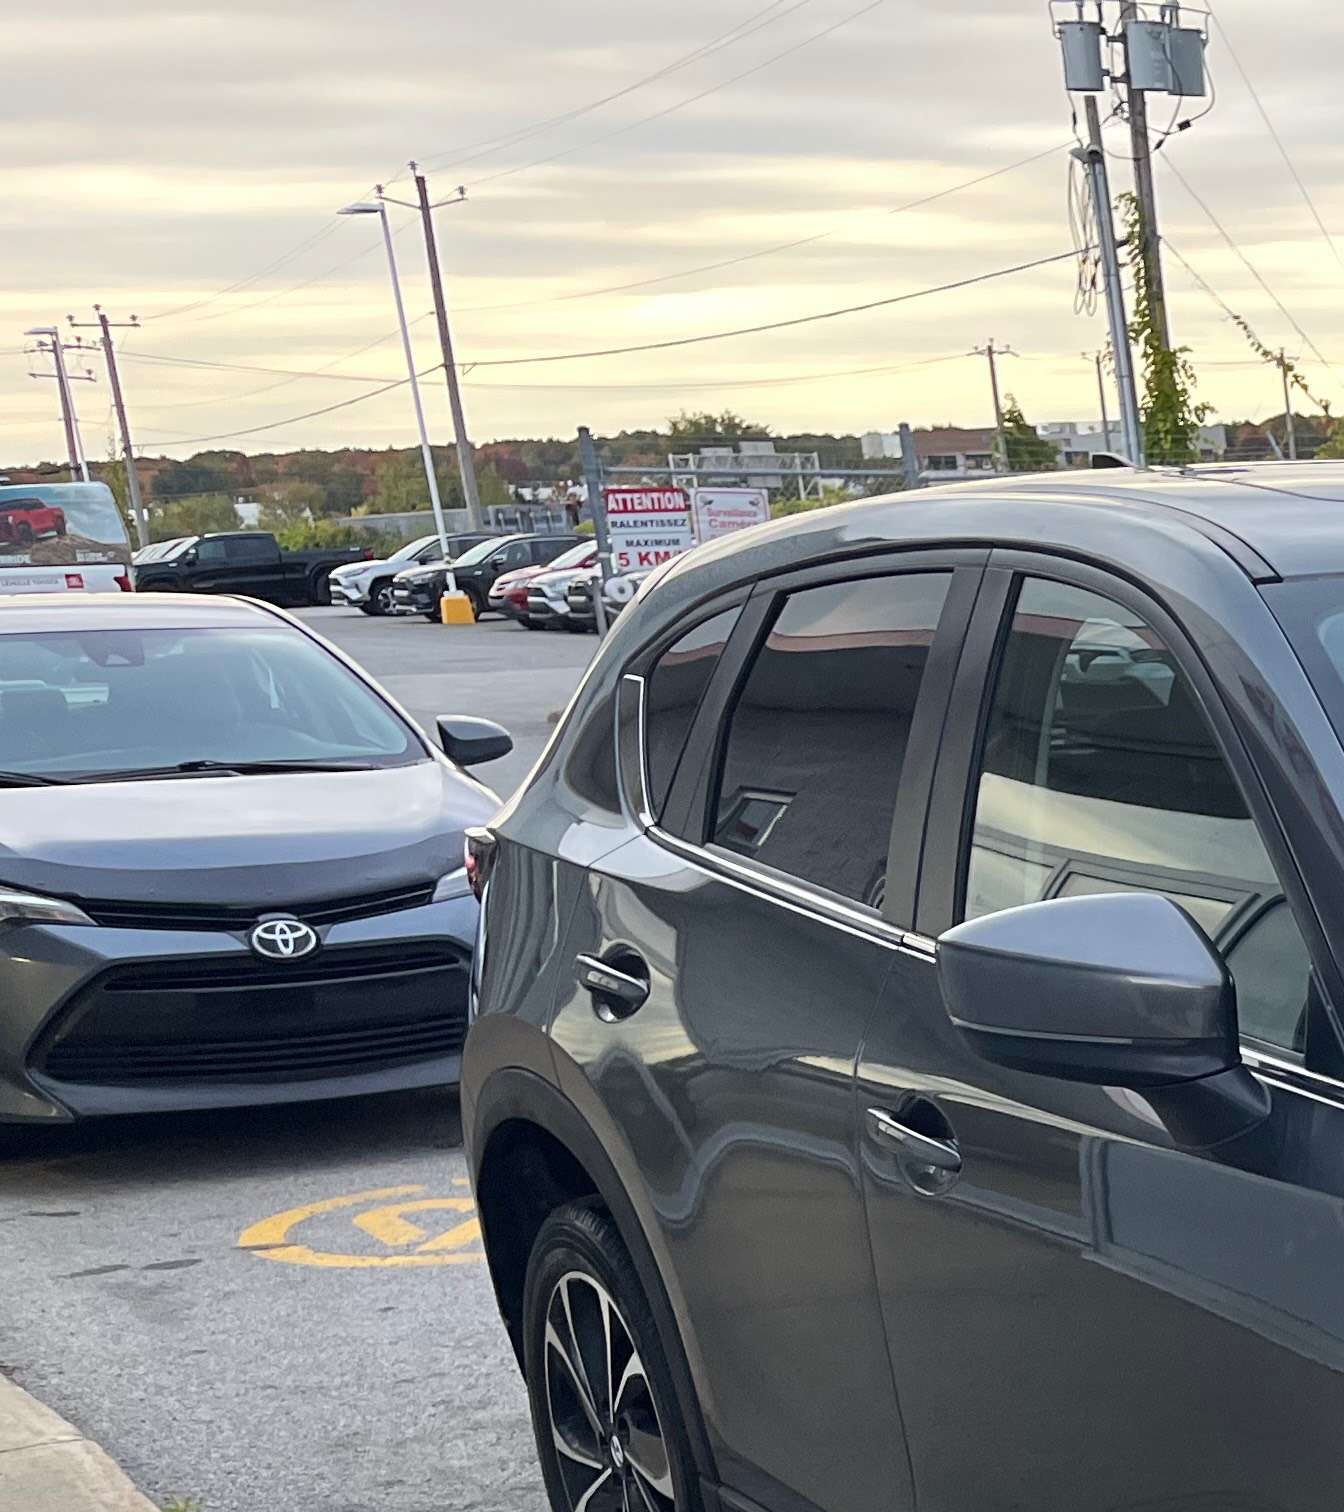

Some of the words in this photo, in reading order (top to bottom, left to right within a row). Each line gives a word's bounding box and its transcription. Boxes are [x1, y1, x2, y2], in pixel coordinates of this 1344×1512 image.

[607, 492, 685, 511] ATTENTION
[610, 519, 687, 528] RALENTISSEZ
[625, 539, 680, 547] MAXIMUM
[618, 552, 630, 567] 5
[638, 551, 683, 566] KM
